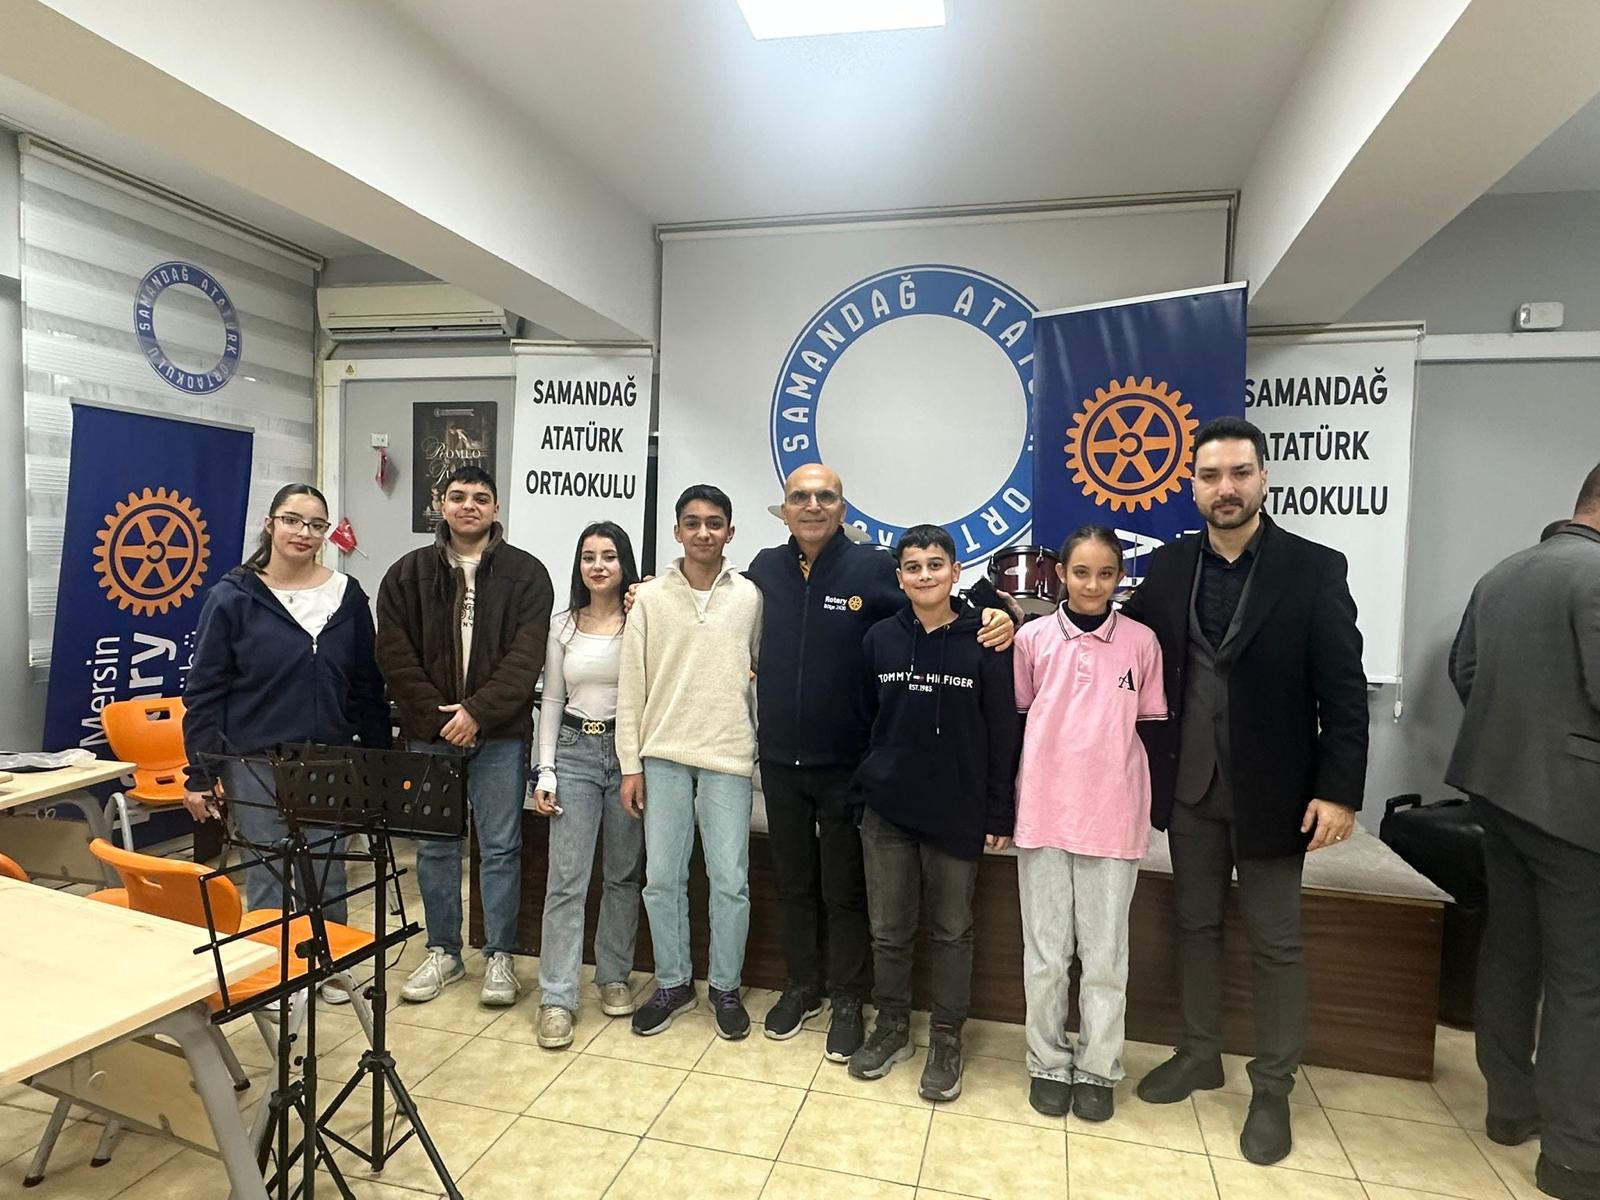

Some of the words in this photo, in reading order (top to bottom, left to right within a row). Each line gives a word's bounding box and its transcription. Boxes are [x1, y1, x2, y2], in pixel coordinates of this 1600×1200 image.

[782, 274, 916, 453] SAMANDAĞ
[533, 375, 638, 407] SAMANDAĞ
[1245, 366, 1388, 407] SAMANDAĞ
[541, 421, 624, 453] ATATÜRK
[526, 470, 636, 499] ORTAOKULU
[1261, 485, 1388, 515] TAOKULU
[824, 595, 848, 606] Rotary
[79, 636, 121, 747] Mersin
[878, 672, 912, 683] TOMMY
[1118, 667, 1136, 692] A
